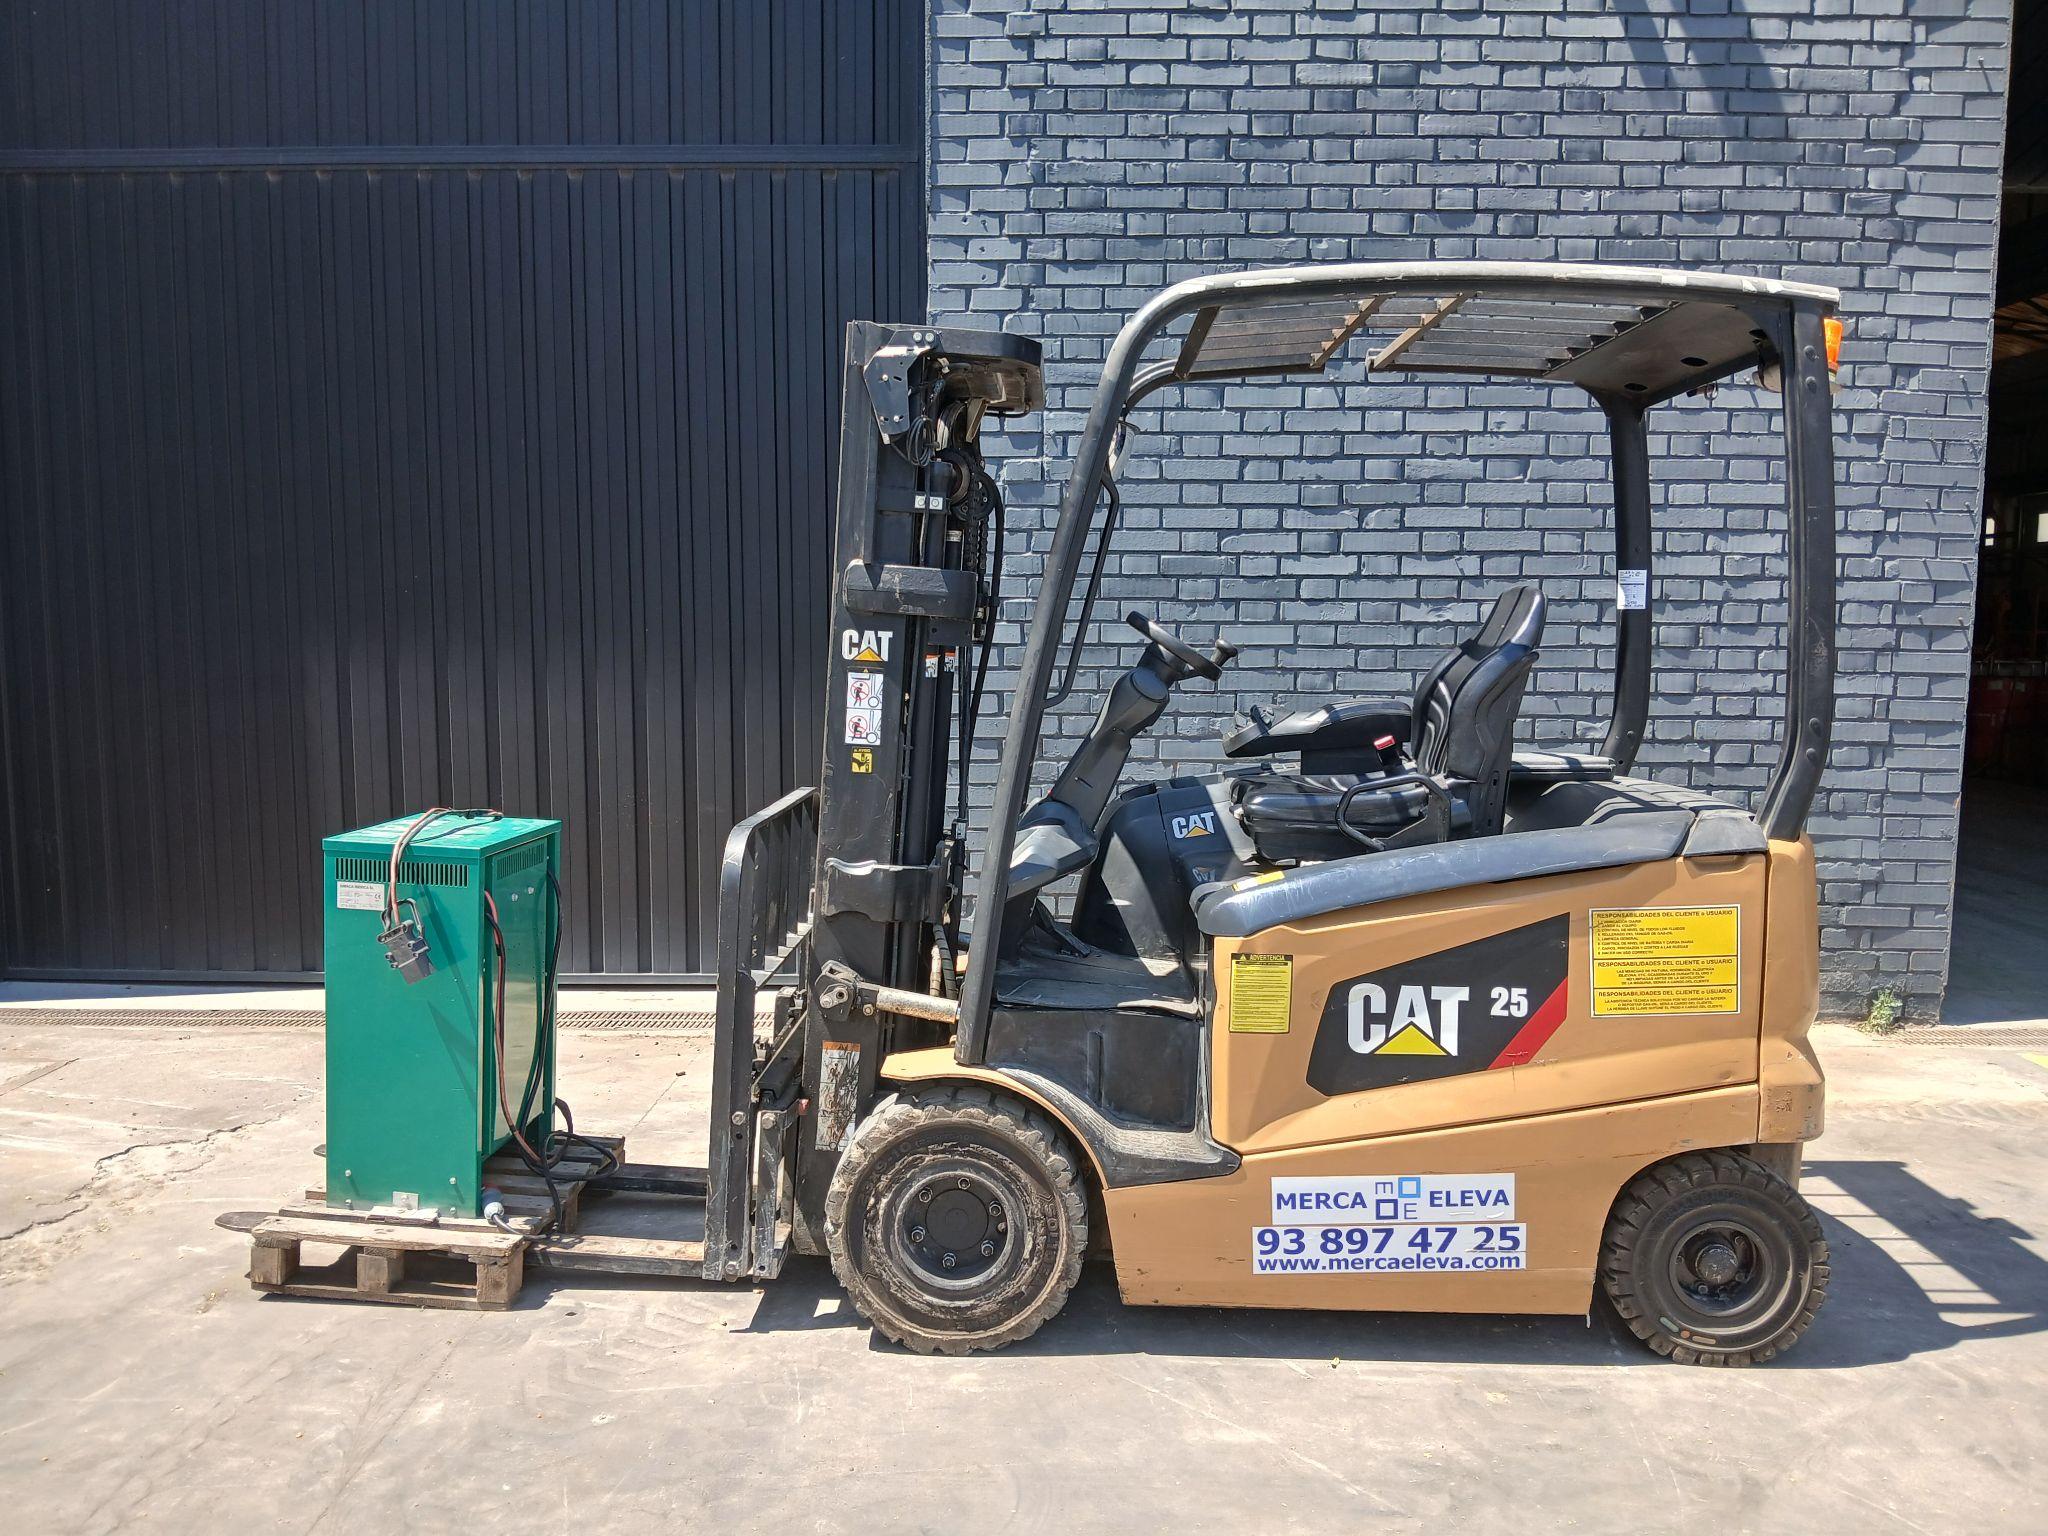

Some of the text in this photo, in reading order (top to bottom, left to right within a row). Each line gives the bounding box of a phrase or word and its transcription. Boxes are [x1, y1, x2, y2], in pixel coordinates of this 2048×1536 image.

[842, 630, 894, 662] CAT
[1172, 811, 1215, 839] CAT
[1346, 982, 1470, 1057] CAT
[1490, 986, 1528, 1018] 25
[1276, 1190, 1510, 1210] MERCA ELEVA
[1256, 1226, 1521, 1256] 93 897 47 25
[1258, 1253, 1520, 1271] www.mercaeleva.com
